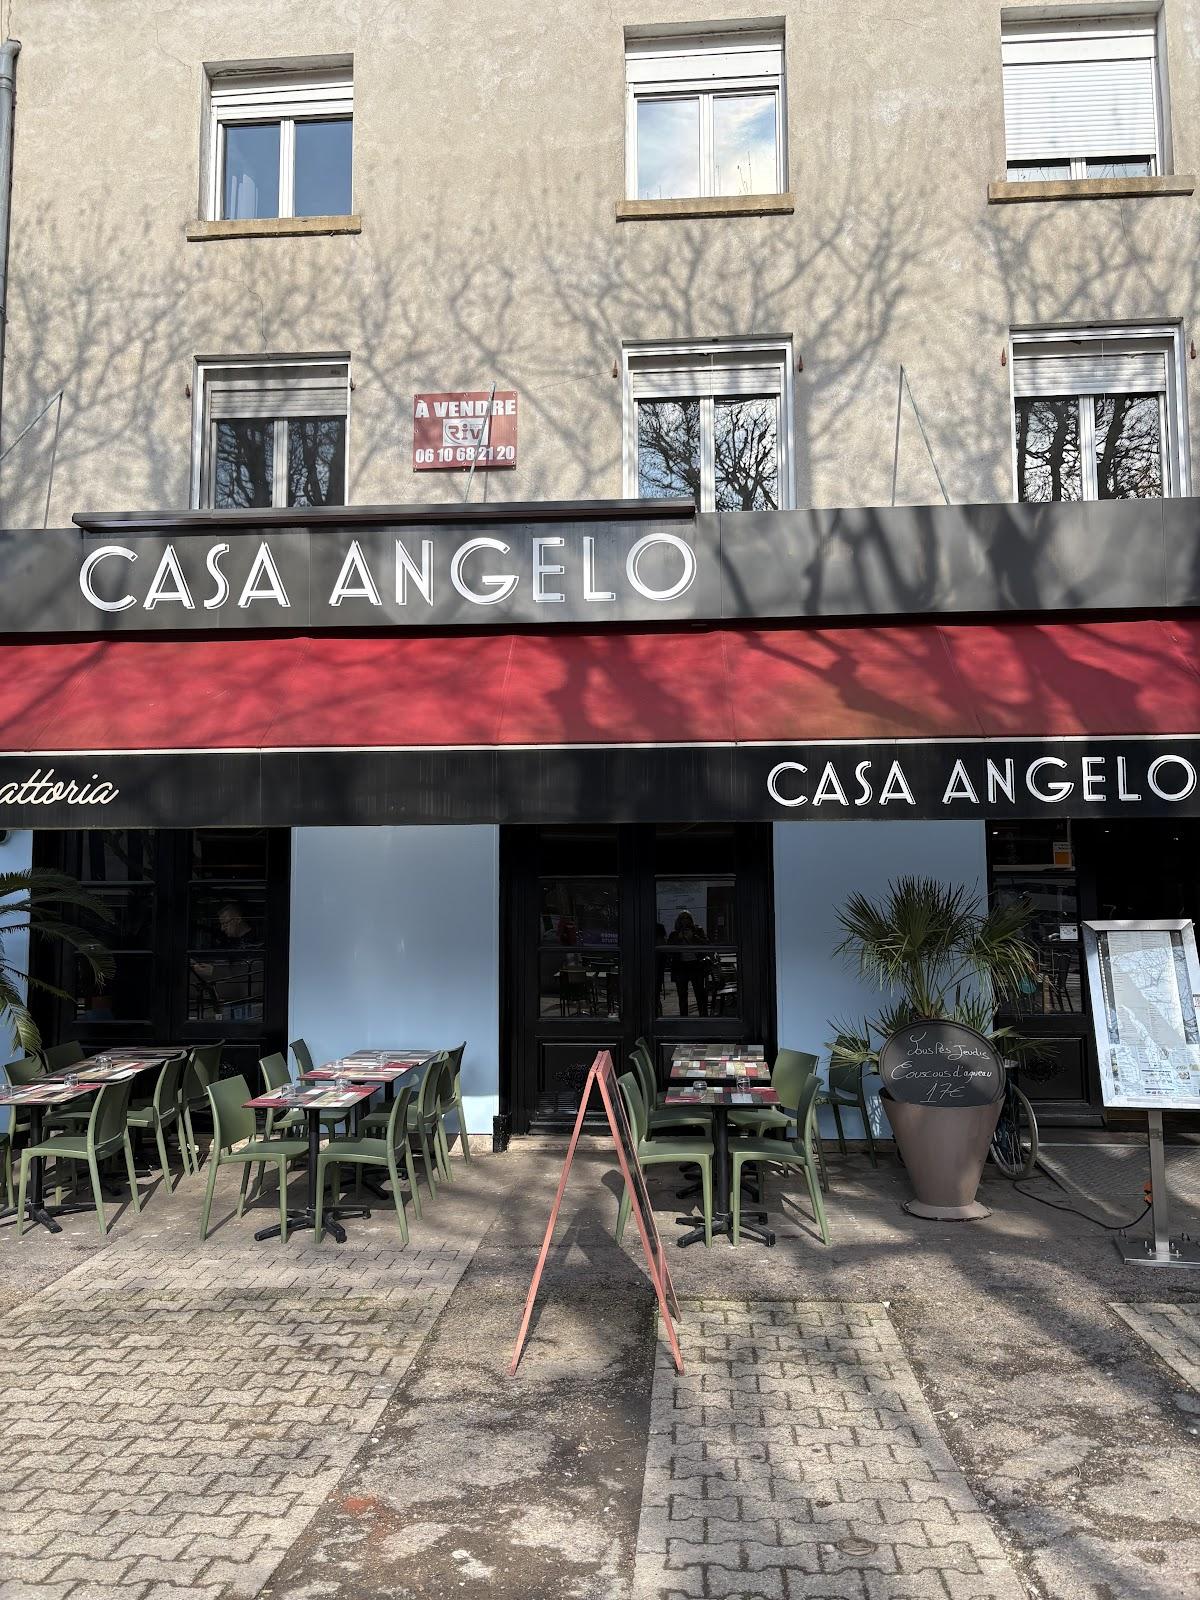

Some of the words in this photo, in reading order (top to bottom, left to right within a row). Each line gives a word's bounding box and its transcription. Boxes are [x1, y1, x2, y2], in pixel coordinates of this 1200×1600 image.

[415, 400, 430, 418] À
[433, 400, 516, 417] VENDRE
[415, 448, 434, 463] 06
[437, 447, 453, 462] 10
[456, 447, 475, 461] 68
[477, 446, 494, 460] 21
[496, 445, 515, 460] 20
[79, 541, 291, 613] CASA
[328, 532, 697, 608] ANGELO
[0, 768, 120, 805] attoria
[766, 759, 917, 808] CASA
[942, 754, 1198, 805] ANGELO
[890, 1060, 951, 1080] Couscous
